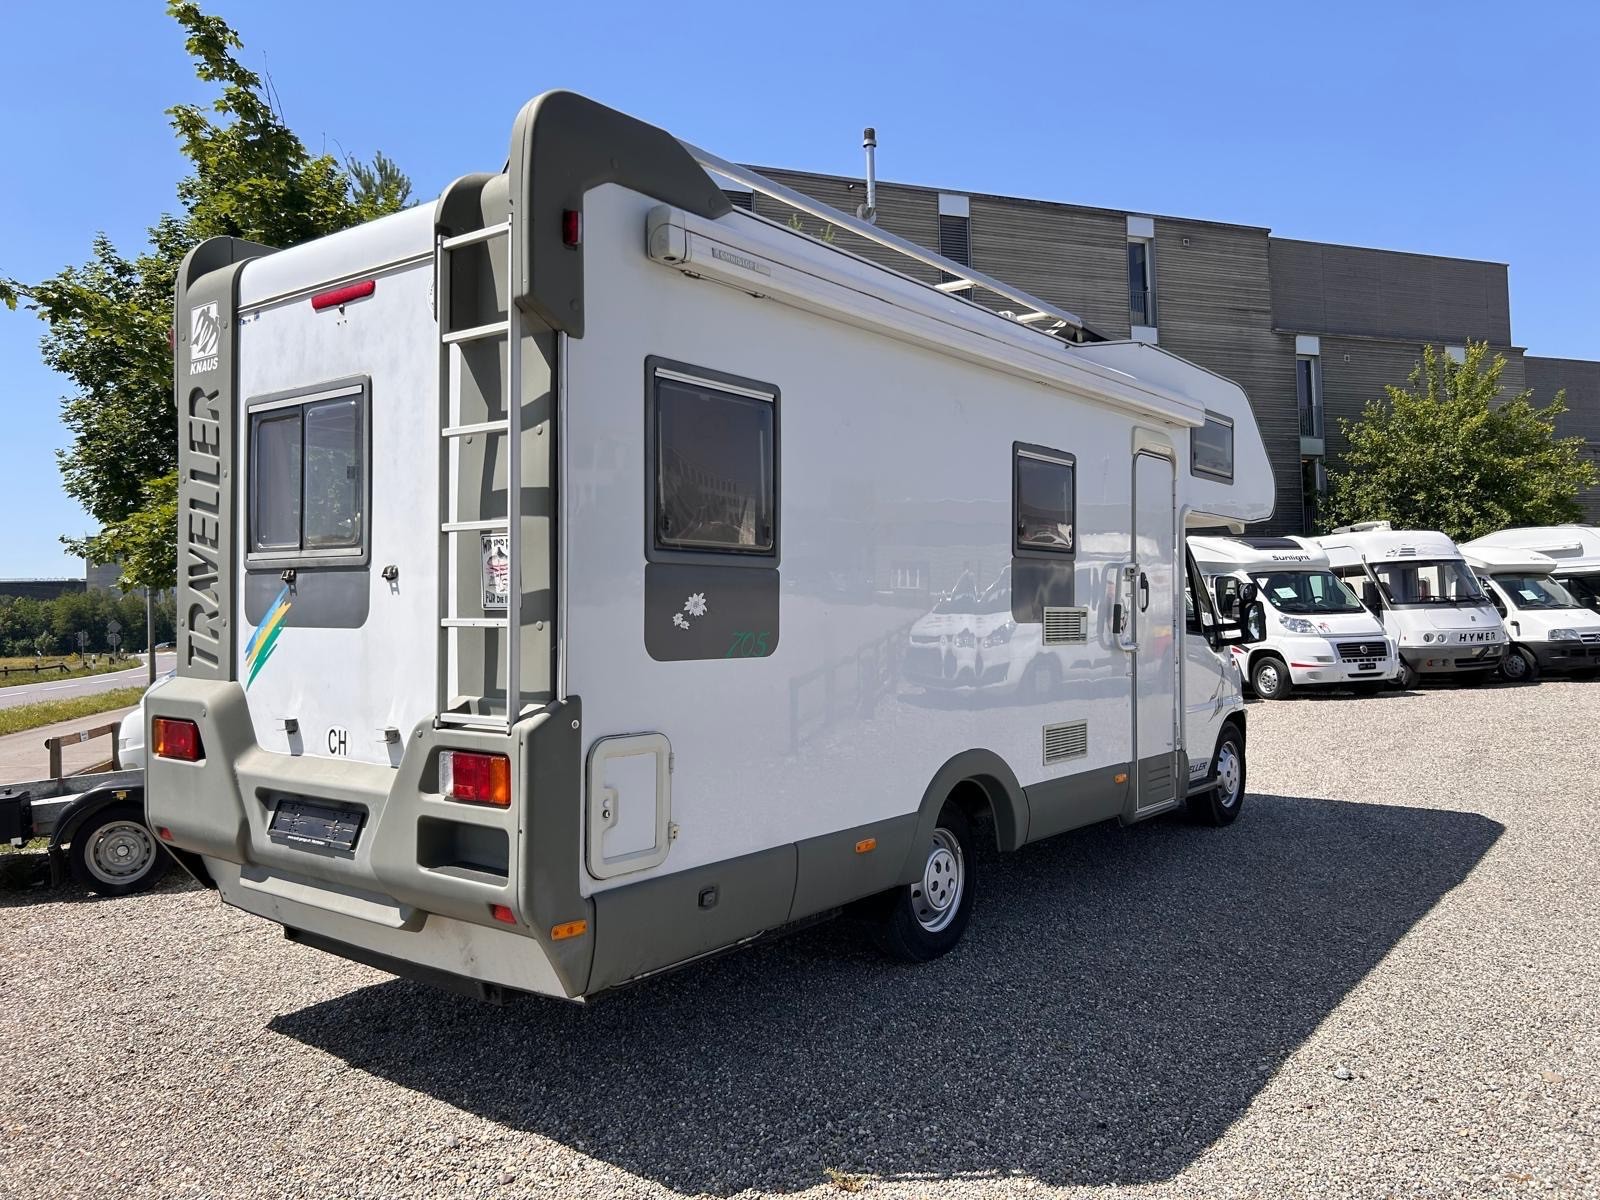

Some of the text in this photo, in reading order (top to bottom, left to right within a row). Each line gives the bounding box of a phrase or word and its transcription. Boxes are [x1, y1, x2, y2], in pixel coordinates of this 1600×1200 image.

[190, 358, 219, 375] KNAUS
[189, 386, 220, 669] TRAVELLER
[1272, 554, 1311, 562] Sunlight
[726, 631, 769, 658] 705
[1459, 632, 1496, 642] HYMER
[328, 729, 347, 756] CH
